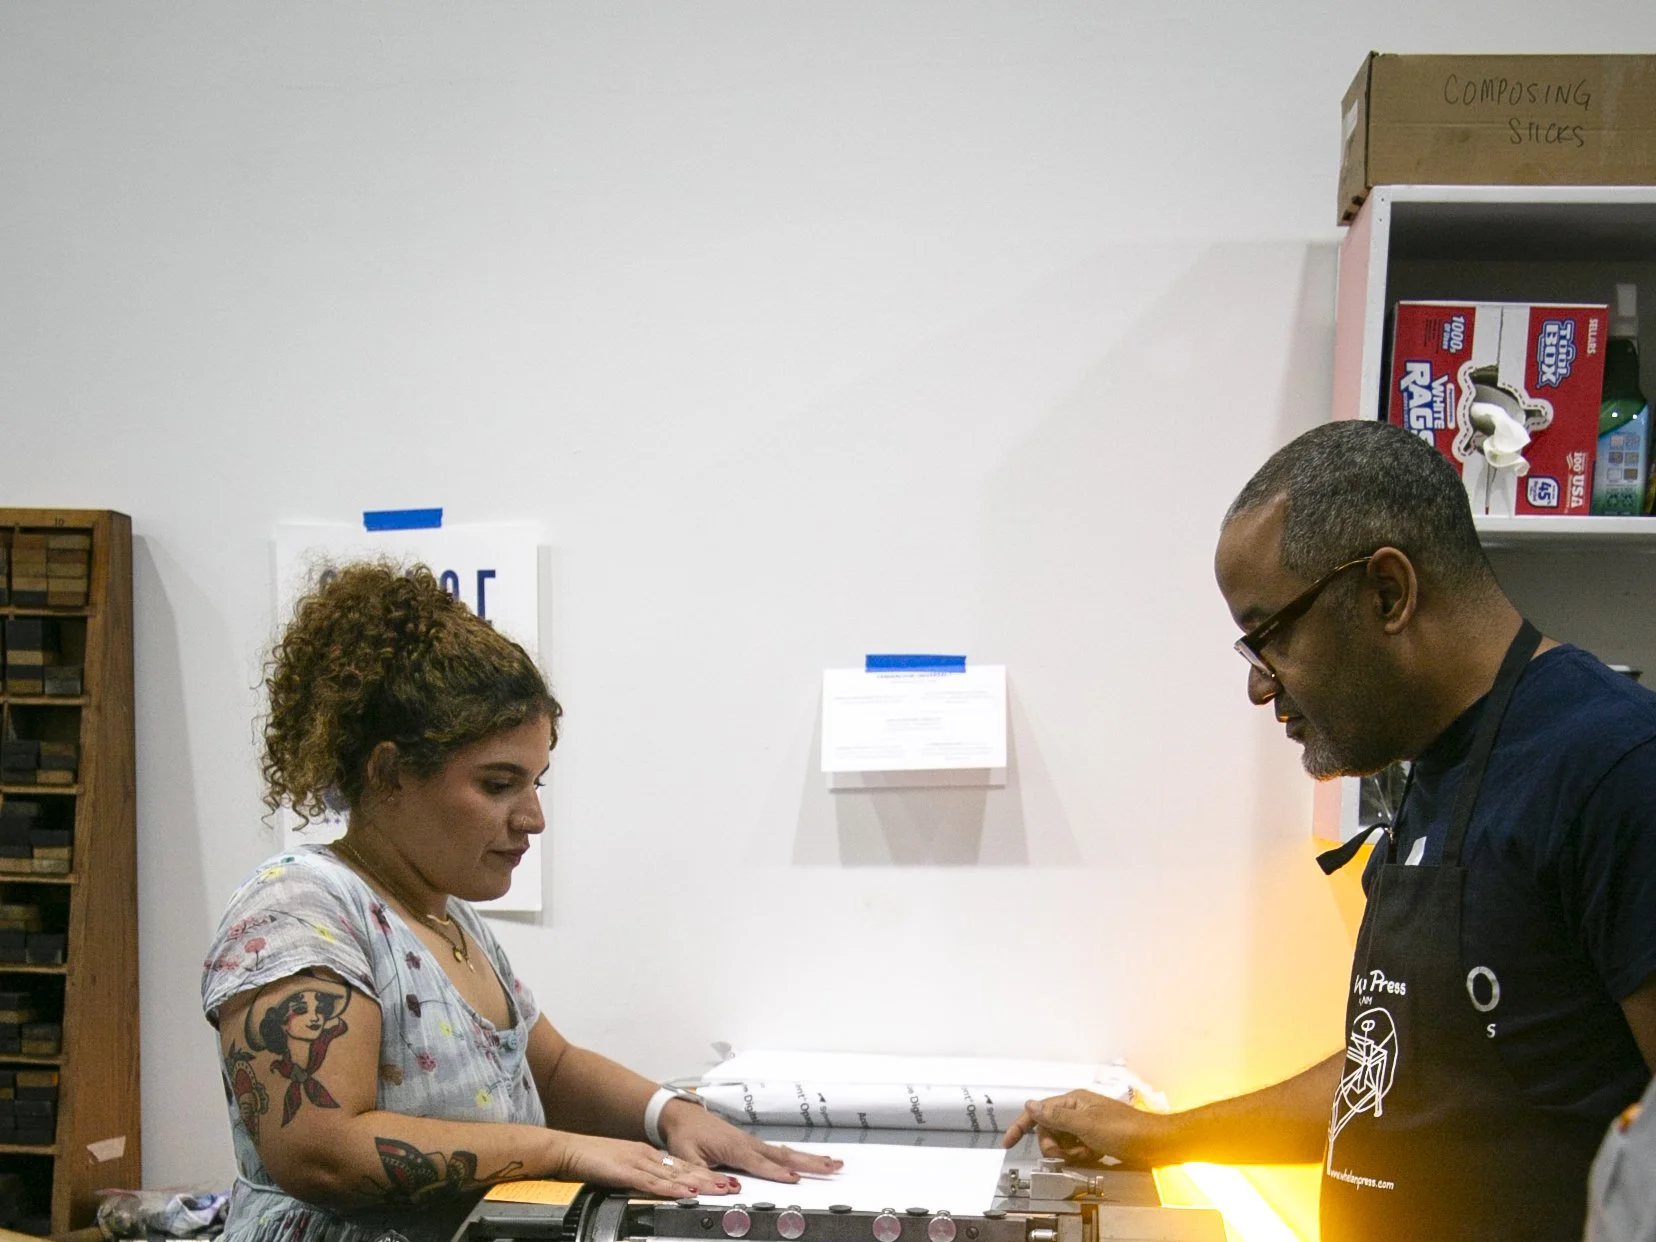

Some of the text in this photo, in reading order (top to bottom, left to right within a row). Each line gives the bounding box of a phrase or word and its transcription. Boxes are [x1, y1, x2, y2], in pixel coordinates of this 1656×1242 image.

[1444, 74, 1591, 111] COMPOSING
[1508, 118, 1584, 148] STICKS
[1542, 324, 1559, 385] BOX
[1571, 475, 1585, 508] USA
[1370, 970, 1406, 996] Press
